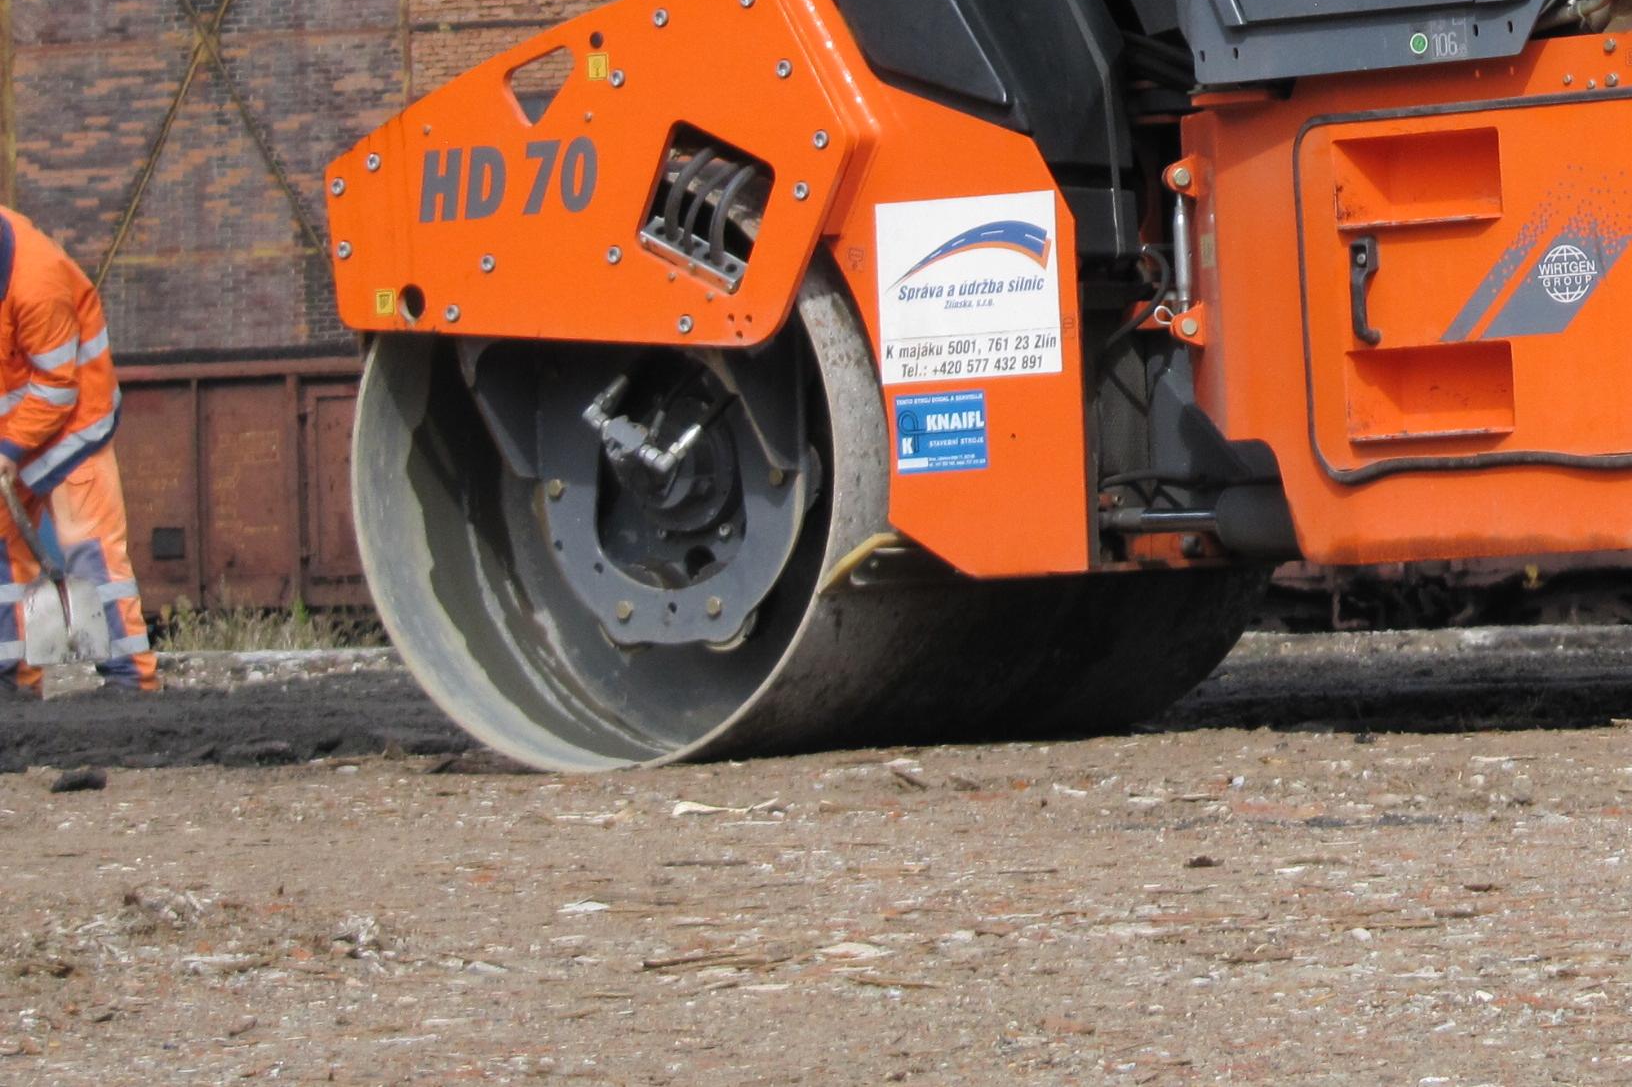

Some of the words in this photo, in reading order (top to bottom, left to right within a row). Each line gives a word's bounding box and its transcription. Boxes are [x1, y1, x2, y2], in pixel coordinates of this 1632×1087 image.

[1431, 31, 1458, 57] 106
[419, 145, 507, 223] HD
[522, 135, 598, 215] 70
[1538, 260, 1596, 275] WIRTGEN
[898, 284, 943, 302] Správa
[947, 284, 955, 297] a
[959, 279, 1004, 296] údržba
[1007, 275, 1045, 293] silnic
[1542, 274, 1592, 287] GROUP
[886, 344, 895, 359] K
[899, 342, 943, 360] majáku
[948, 339, 982, 355] 5001,
[988, 337, 1009, 352] 761
[1014, 335, 1030, 350] 23
[1034, 333, 1057, 349] Zlín
[901, 363, 928, 378] Tel.:
[932, 360, 962, 376] +420
[967, 358, 989, 373] 577
[994, 356, 1017, 371] 432
[1022, 354, 1043, 370] 891
[926, 411, 984, 431] KNAIFL
[902, 437, 914, 455] K
